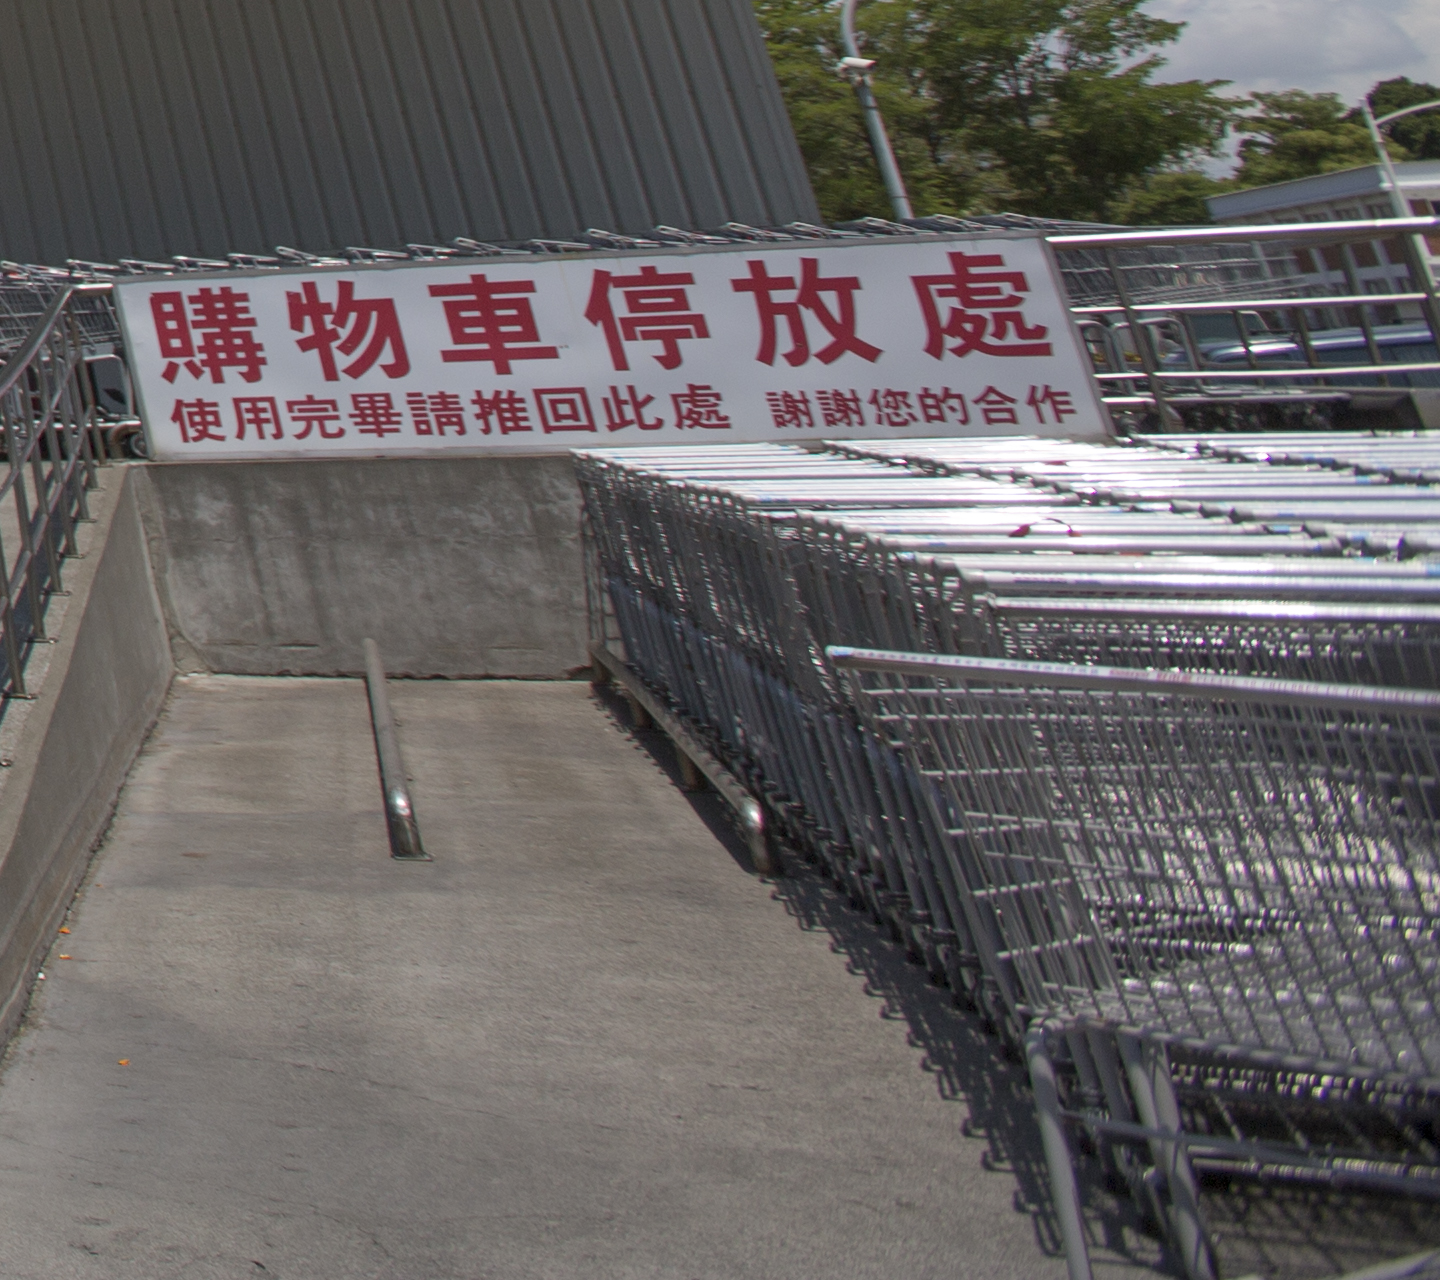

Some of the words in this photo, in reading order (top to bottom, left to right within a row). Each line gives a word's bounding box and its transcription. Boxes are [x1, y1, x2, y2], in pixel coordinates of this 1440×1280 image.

[150, 252, 1053, 385] 購物車停放處
[171, 382, 731, 442] 使用完畢請推回此處
[767, 384, 1077, 430] 謝謝您的合作
